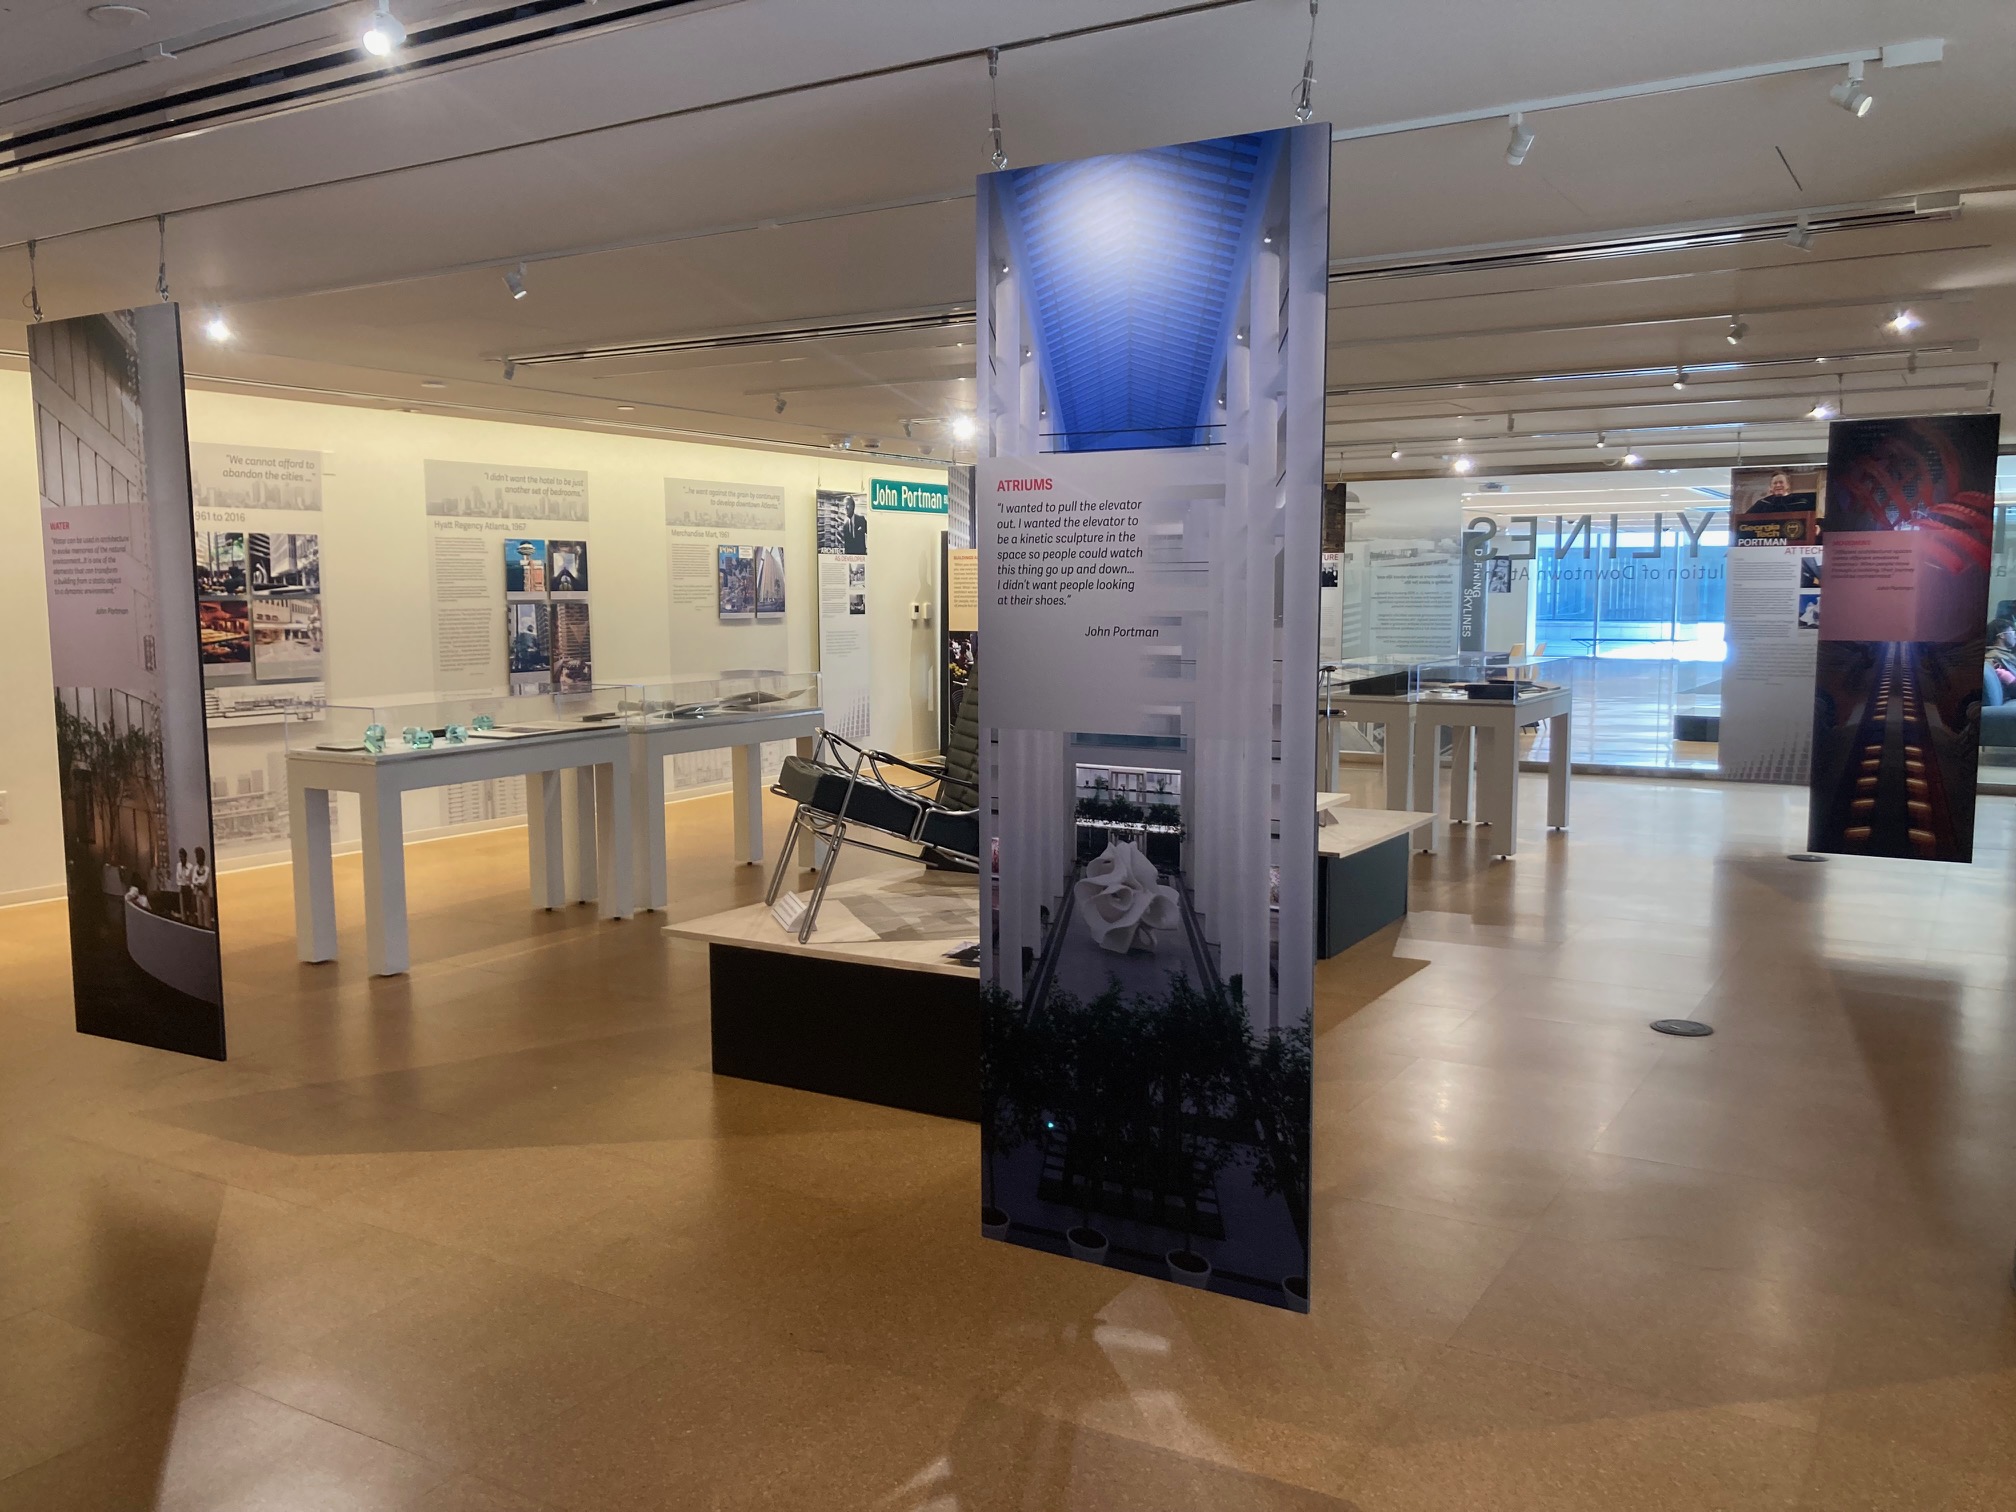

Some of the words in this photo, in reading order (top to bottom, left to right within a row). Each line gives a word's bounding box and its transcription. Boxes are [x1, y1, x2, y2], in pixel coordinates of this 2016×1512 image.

[245, 458, 276, 467] cannot
[278, 458, 304, 470] afford
[306, 461, 315, 470] to
[222, 468, 263, 479] abandon
[264, 470, 280, 480] the
[281, 472, 304, 482] cities
[510, 476, 526, 484] want
[527, 476, 538, 484] the
[539, 476, 555, 484] hotel
[572, 479, 584, 488] just
[996, 478, 1053, 492] ATRIUMS
[504, 486, 530, 494] another
[532, 487, 542, 495] set
[542, 488, 550, 496] of
[873, 483, 898, 506] John
[901, 486, 942, 509] Portman
[997, 502, 1004, 514] "I
[1006, 502, 1043, 513] wanted
[1046, 502, 1056, 512] to
[1058, 500, 1078, 514] pull
[1079, 500, 1096, 512] the
[1098, 500, 1142, 511] elevator
[194, 511, 210, 521] 961
[213, 512, 223, 522] to
[224, 512, 246, 522] 2016
[996, 518, 1016, 529] out.
[1018, 518, 1022, 528] I
[1023, 517, 1062, 528] wanted
[1063, 517, 1080, 528] the
[1082, 516, 1126, 528] elevator
[1127, 516, 1139, 526] to
[50, 522, 70, 530] WATER
[434, 521, 454, 530] Hyatt
[454, 521, 484, 532] Regency
[512, 523, 527, 531] 1967
[1739, 523, 1780, 533] Georgia
[671, 529, 704, 538] Merchandise
[997, 534, 1009, 544] be
[1011, 536, 1018, 544] a
[1020, 532, 1053, 544] kinetic
[1055, 532, 1104, 546] sculpture
[1106, 532, 1116, 542] in
[1118, 531, 1136, 542] the
[1754, 530, 1780, 538] Tech
[1738, 538, 1788, 546] PORTMAN
[997, 550, 1027, 562] space
[1028, 550, 1041, 560] so
[1042, 548, 1077, 562] people
[1078, 548, 1108, 559] could
[1110, 546, 1143, 558] watch
[1784, 546, 1797, 554] AT
[1800, 546, 1824, 554] TECH
[997, 565, 1016, 576] this
[1018, 564, 1044, 578] thing
[1046, 566, 1058, 578] go
[1060, 566, 1074, 576] up
[1076, 564, 1096, 574] and
[1098, 564, 1135, 574] down...
[1472, 548, 1484, 598] DFINING
[997, 580, 1001, 590] I
[1002, 578, 1030, 590] didn't
[1032, 580, 1058, 590] want
[1060, 579, 1094, 592] people
[1096, 578, 1135, 592] looking
[997, 596, 1008, 606] at
[1010, 594, 1033, 606] their
[1034, 594, 1072, 606] shoes."
[1461, 588, 1474, 638] SKYLINES
[1084, 626, 1111, 638] John
[1112, 626, 1159, 638] Portman
